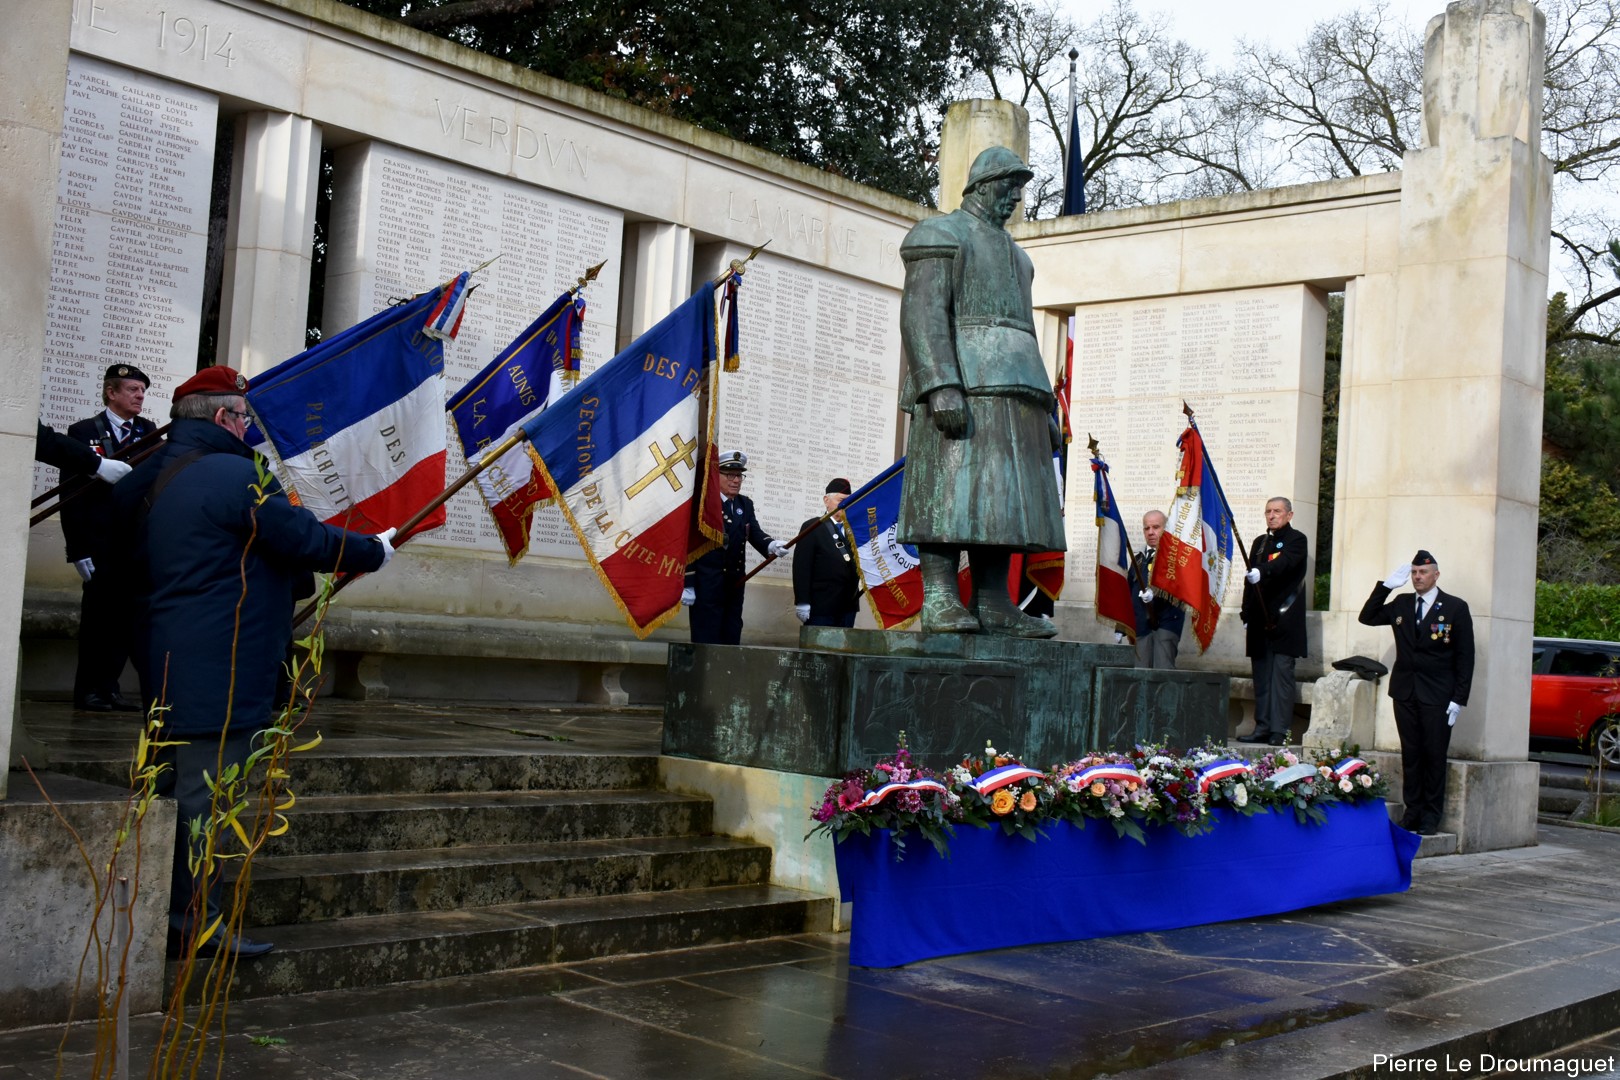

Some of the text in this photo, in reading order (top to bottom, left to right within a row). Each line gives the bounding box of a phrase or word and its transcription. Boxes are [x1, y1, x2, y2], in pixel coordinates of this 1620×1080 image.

[158, 10, 236, 68] 1914
[164, 97, 198, 111] CHARLES
[66, 170, 97, 182] JOSEPH
[149, 172, 168, 182] JEAN
[162, 166, 185, 177] HENRI
[148, 180, 175, 192] PIERRE
[147, 189, 183, 202] RAYMOND
[148, 207, 167, 216] JEAN
[149, 199, 192, 213] ALEXANDRE
[728, 191, 762, 229] LA
[773, 201, 859, 258] MARNE
[62, 269, 100, 281] RAYMOND
[138, 283, 156, 292] YVES
[148, 277, 177, 288] MARCEL
[50, 321, 80, 332] DANIEL
[148, 320, 167, 329] JEAN
[138, 327, 166, 338] ERNEST
[55, 358, 85, 368] VICTOR
[643, 353, 681, 380] DES
[508, 364, 537, 406] AUNIS
[473, 397, 487, 429] LA
[380, 425, 405, 463] DES
[581, 483, 602, 509] DE
[594, 510, 614, 535] LA
[867, 506, 877, 525] DES
[1178, 558, 1189, 567] de
